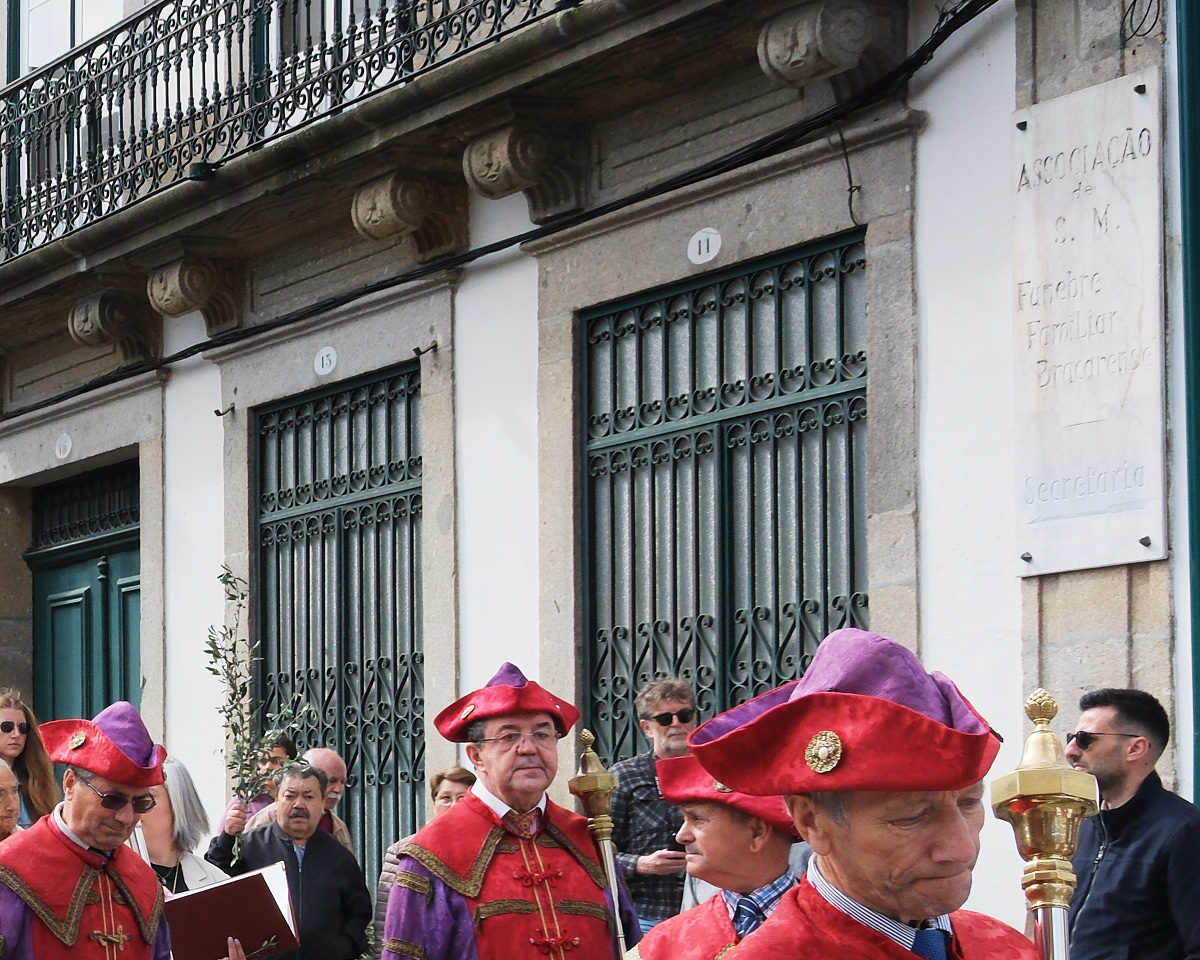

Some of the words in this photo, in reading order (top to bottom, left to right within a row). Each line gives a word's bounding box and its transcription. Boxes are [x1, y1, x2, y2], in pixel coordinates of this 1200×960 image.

[1016, 127, 1152, 193] ASSOCIAÇÃO
[1071, 181, 1095, 200] de
[697, 237, 710, 256] 11
[1036, 346, 1153, 389] Bracarense
[1024, 460, 1145, 505] Secretaria
